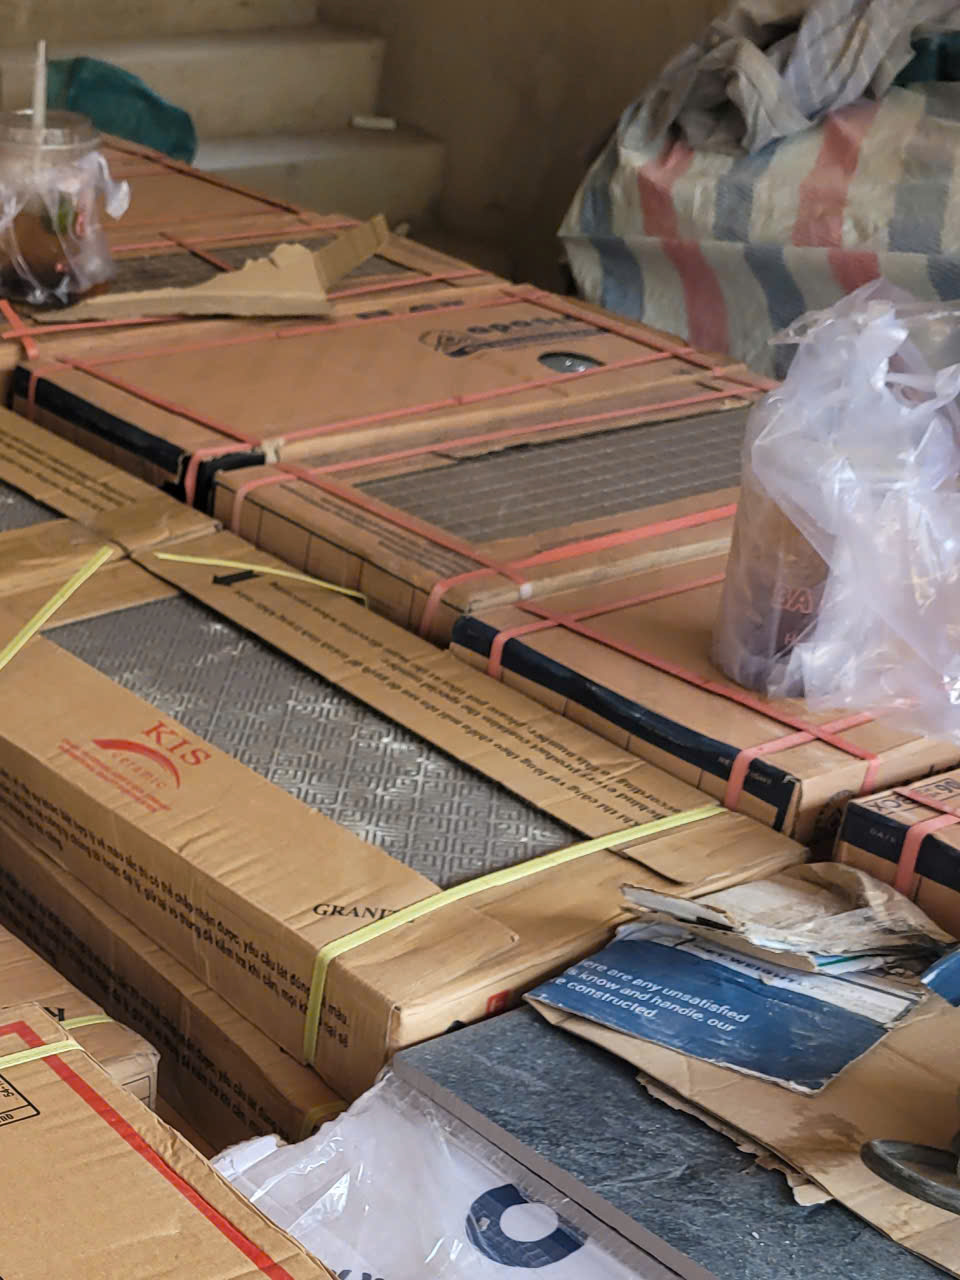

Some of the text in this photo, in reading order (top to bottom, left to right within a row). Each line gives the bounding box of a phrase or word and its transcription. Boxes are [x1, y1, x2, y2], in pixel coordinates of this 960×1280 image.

[142, 720, 212, 767] KIS
[577, 969, 737, 1033] know and handle, our
[606, 967, 751, 1024] are any unsatisfied
